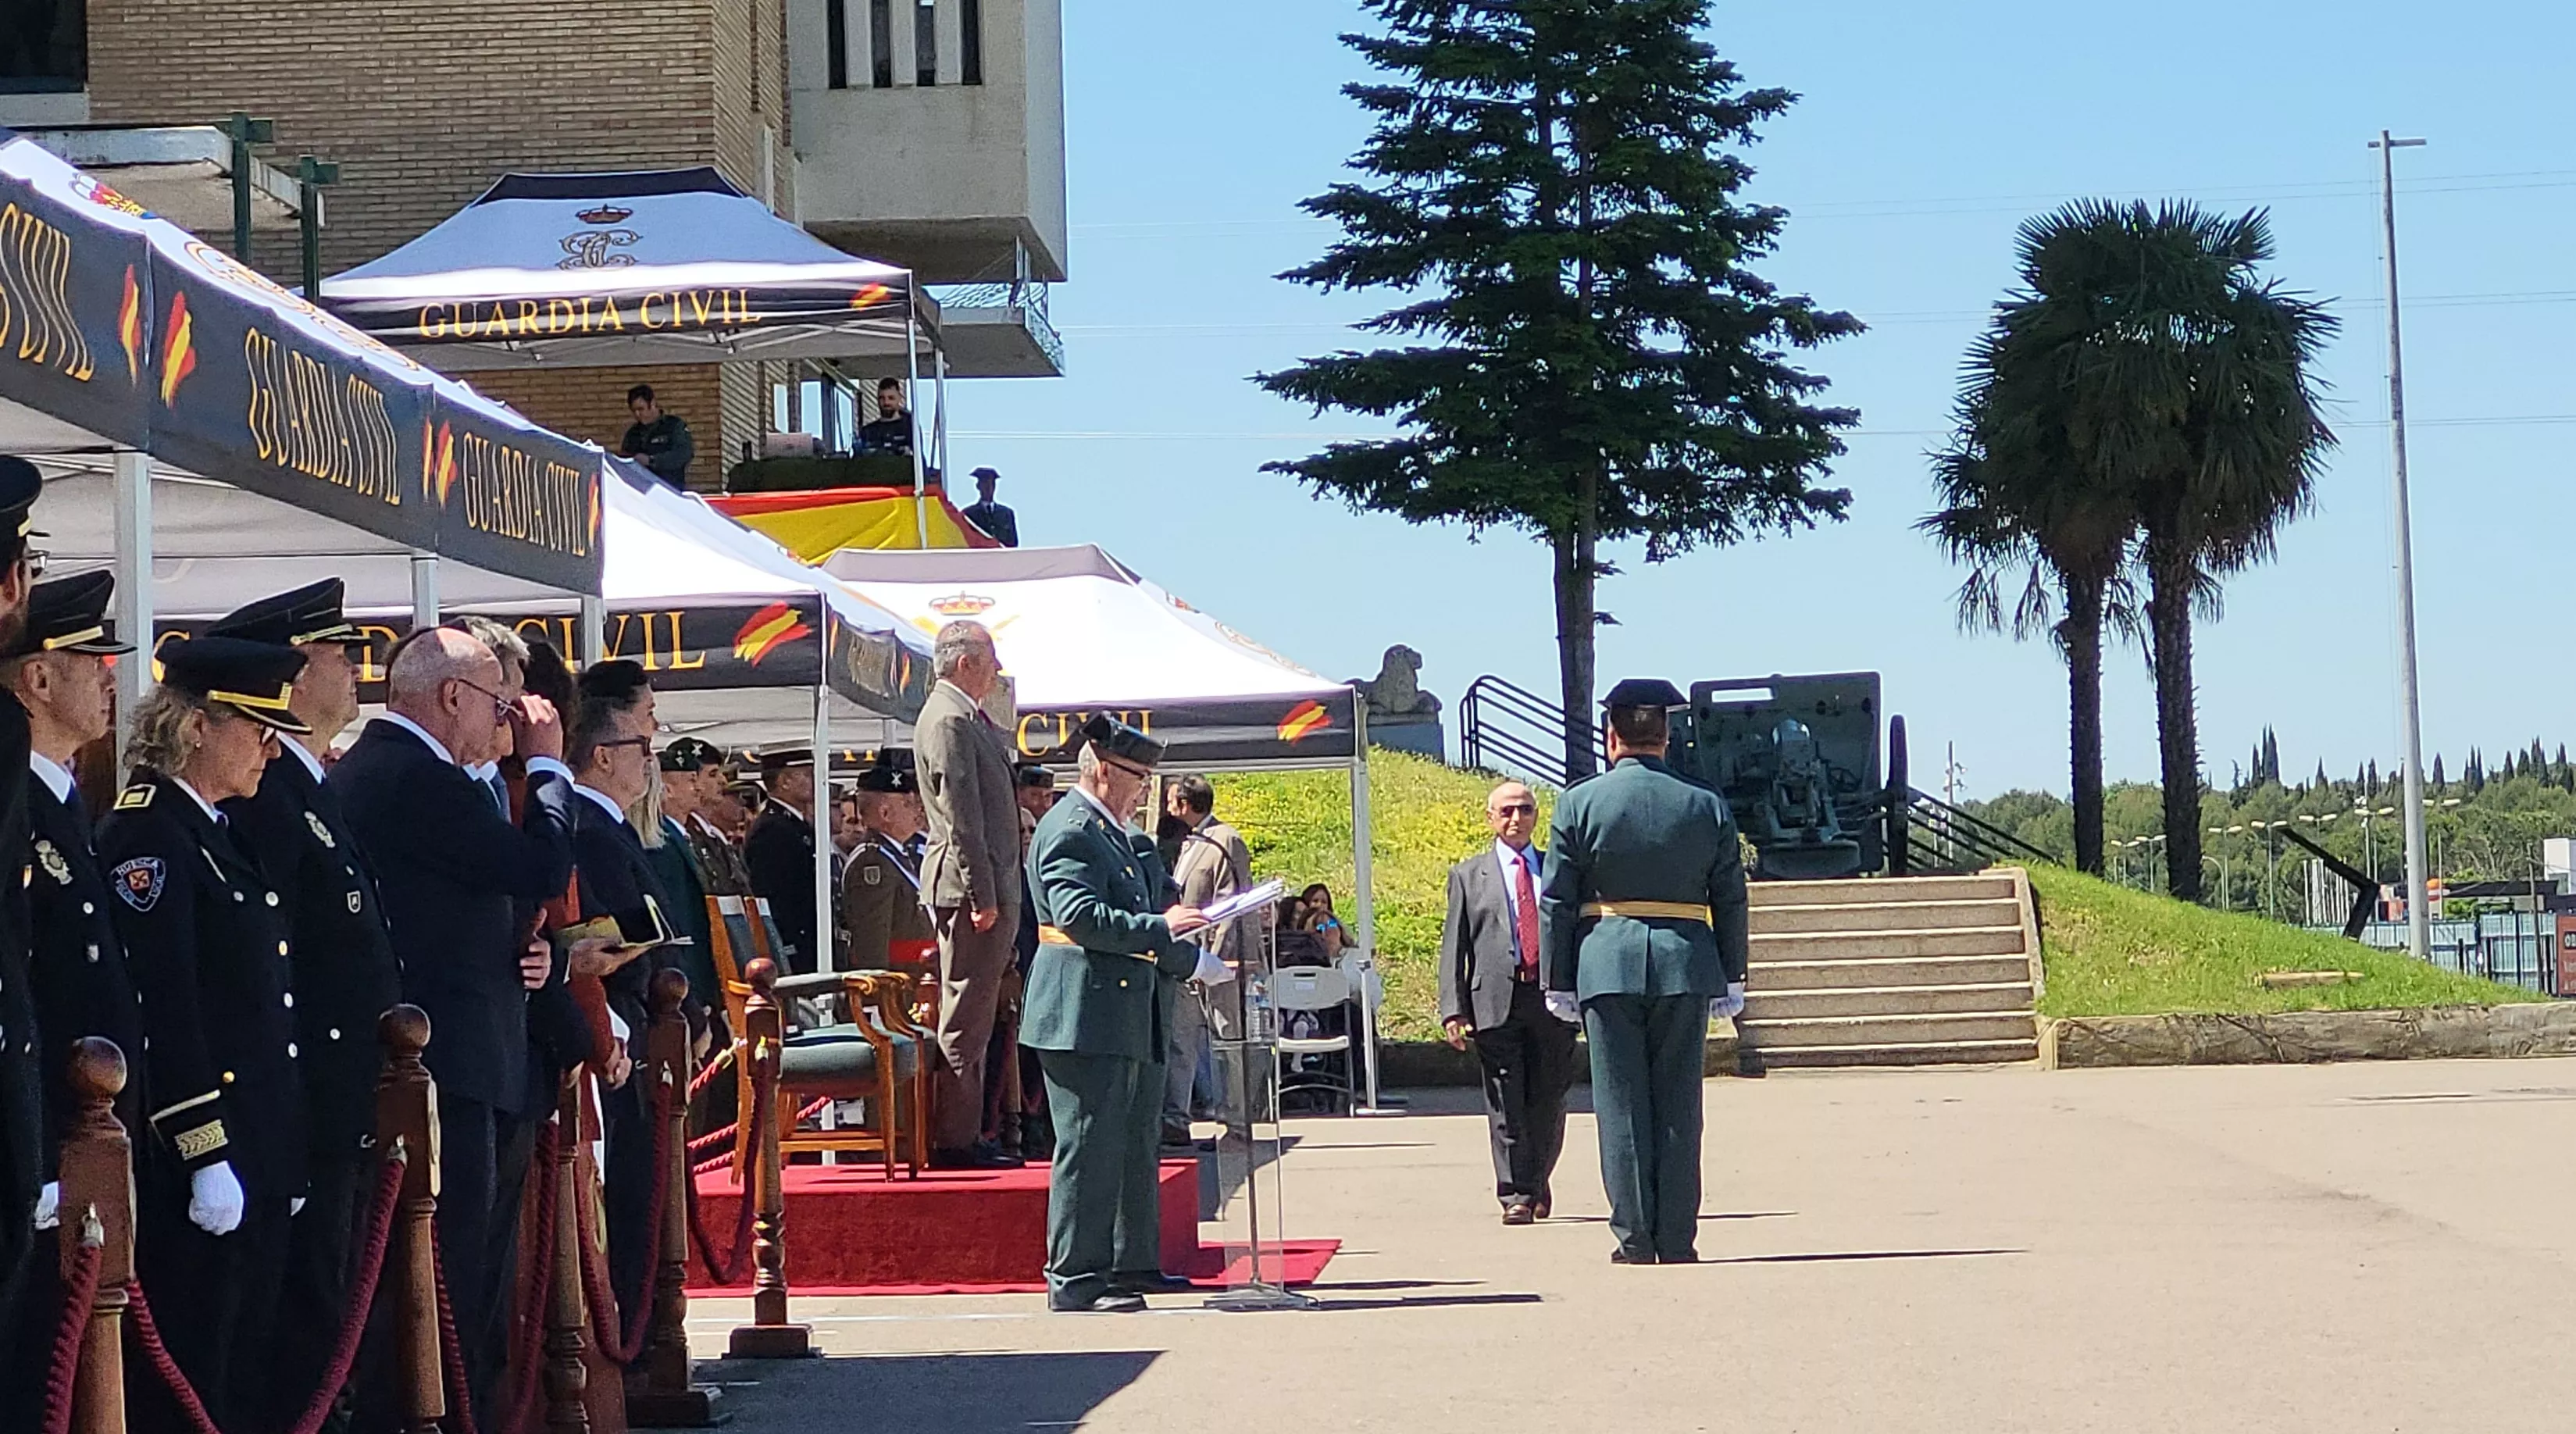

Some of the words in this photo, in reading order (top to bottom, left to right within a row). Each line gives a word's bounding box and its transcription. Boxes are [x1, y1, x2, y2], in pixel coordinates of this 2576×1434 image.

[0, 202, 95, 382] CIVIL
[418, 294, 623, 338] GUARDIA
[639, 288, 762, 330] CIVIL
[244, 326, 351, 488] GUARDIA
[346, 373, 401, 505] CIVIL
[462, 431, 544, 547] GUARDIA
[545, 461, 585, 557] CIVIL
